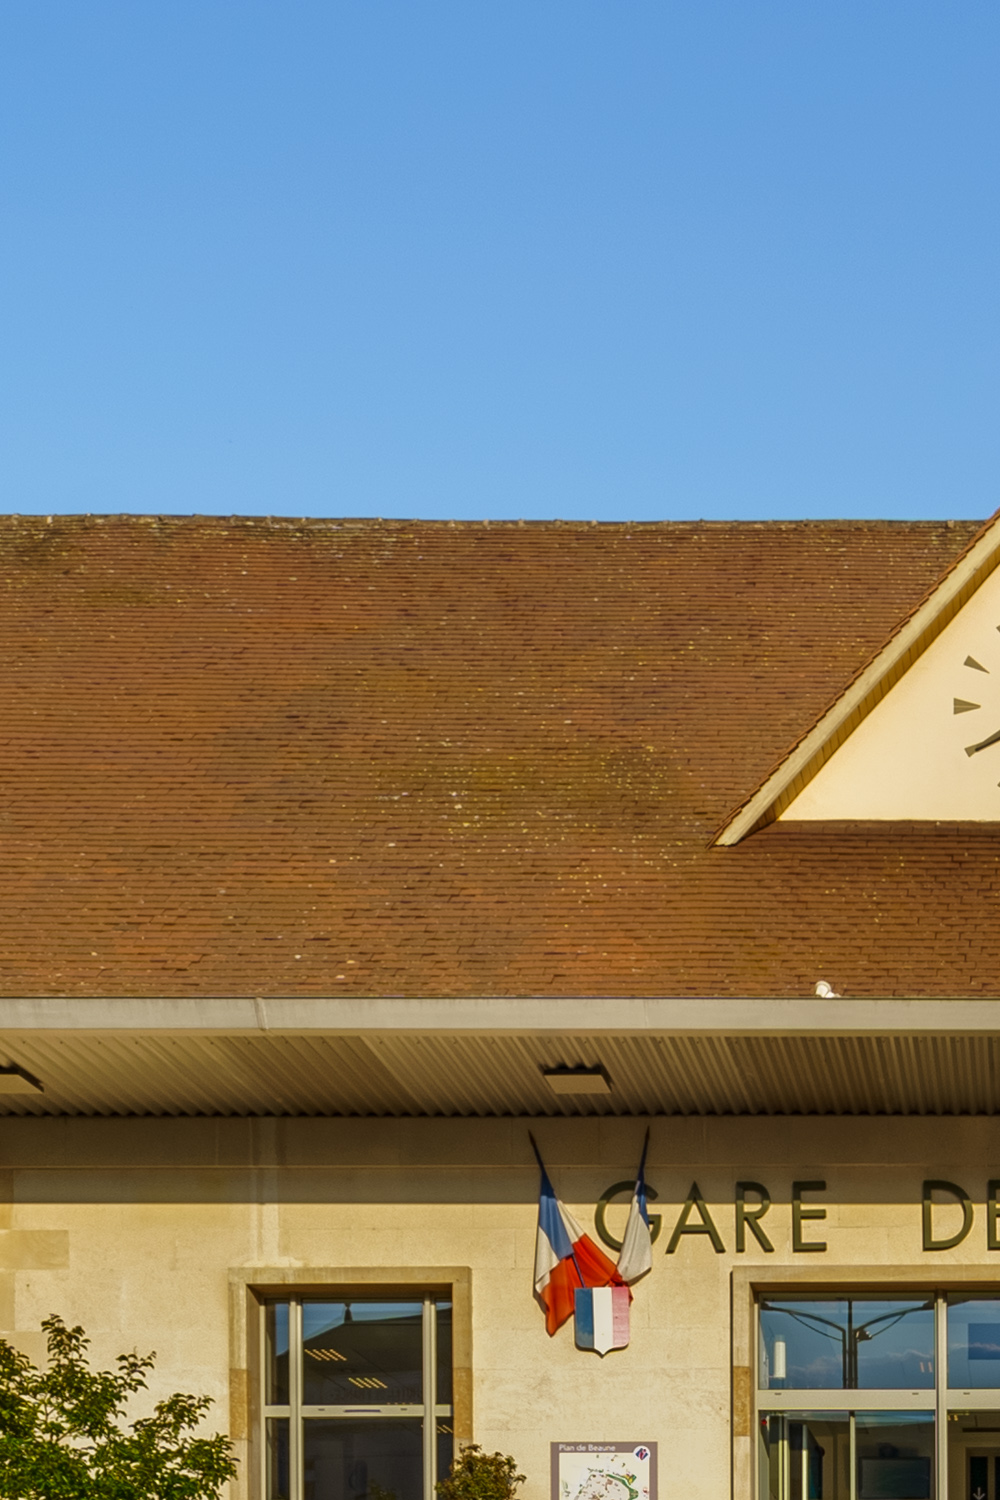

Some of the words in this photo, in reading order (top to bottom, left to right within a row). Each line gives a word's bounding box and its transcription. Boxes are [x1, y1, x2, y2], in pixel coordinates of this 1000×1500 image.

[594, 1179, 827, 1254] GARE
[558, 1443, 575, 1451] Plan
[576, 1443, 586, 1451] de
[587, 1443, 616, 1451] Beaune
